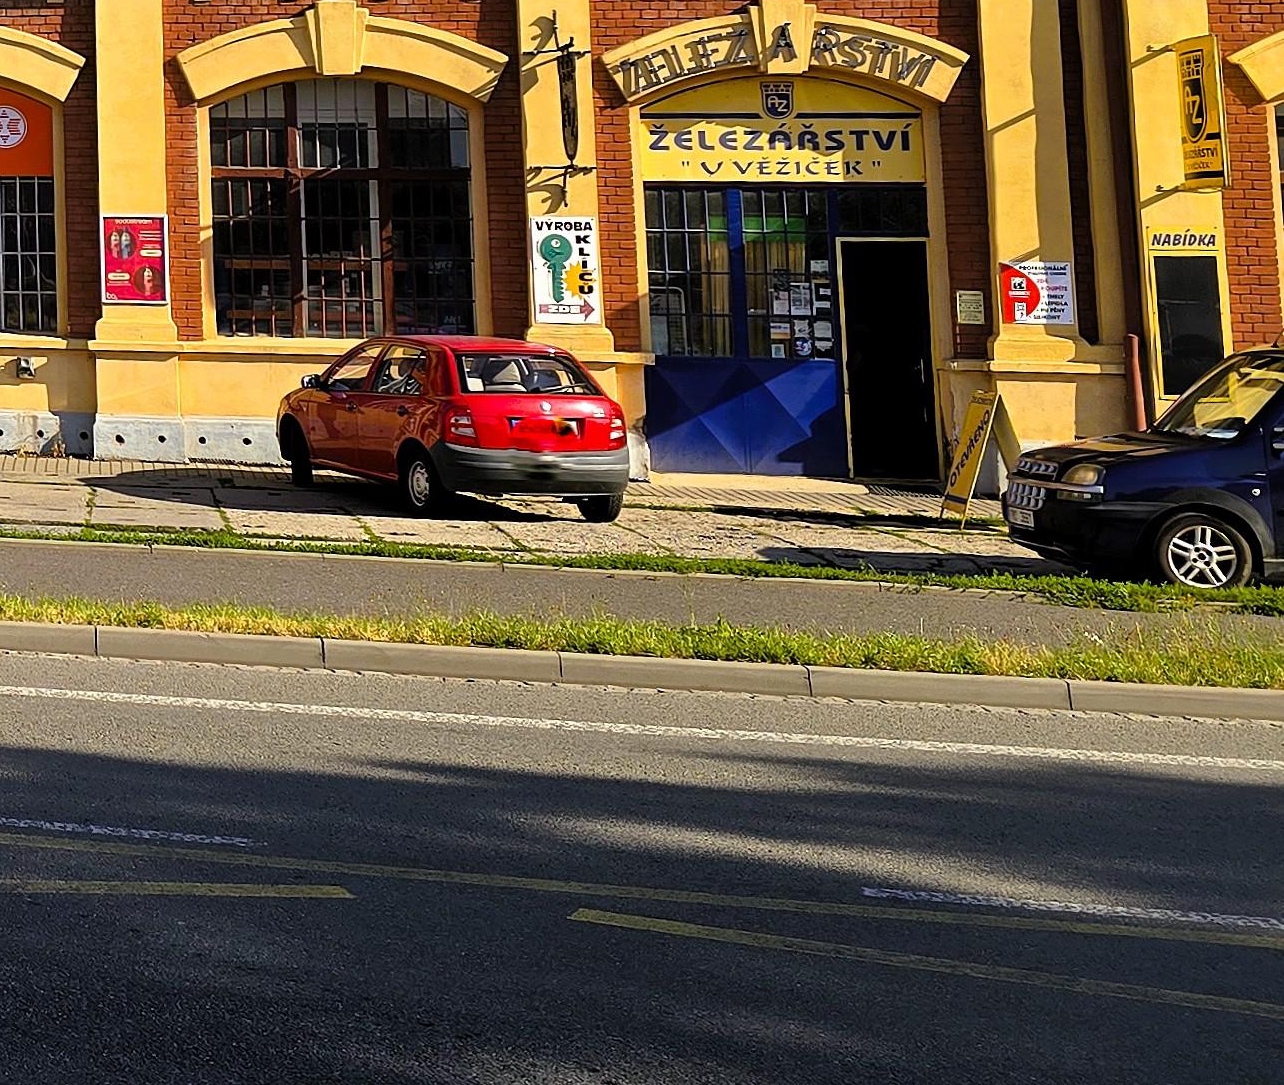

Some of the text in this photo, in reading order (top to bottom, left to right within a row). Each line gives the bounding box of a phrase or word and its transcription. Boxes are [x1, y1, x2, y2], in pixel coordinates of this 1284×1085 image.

[767, 95, 789, 112] AZ
[1184, 85, 1203, 125] AZ
[648, 122, 914, 152] ŽELEZÁŘSTVÍ
[1150, 228, 1217, 247] NABÍDKA
[949, 409, 991, 488] OTEVŘENO
